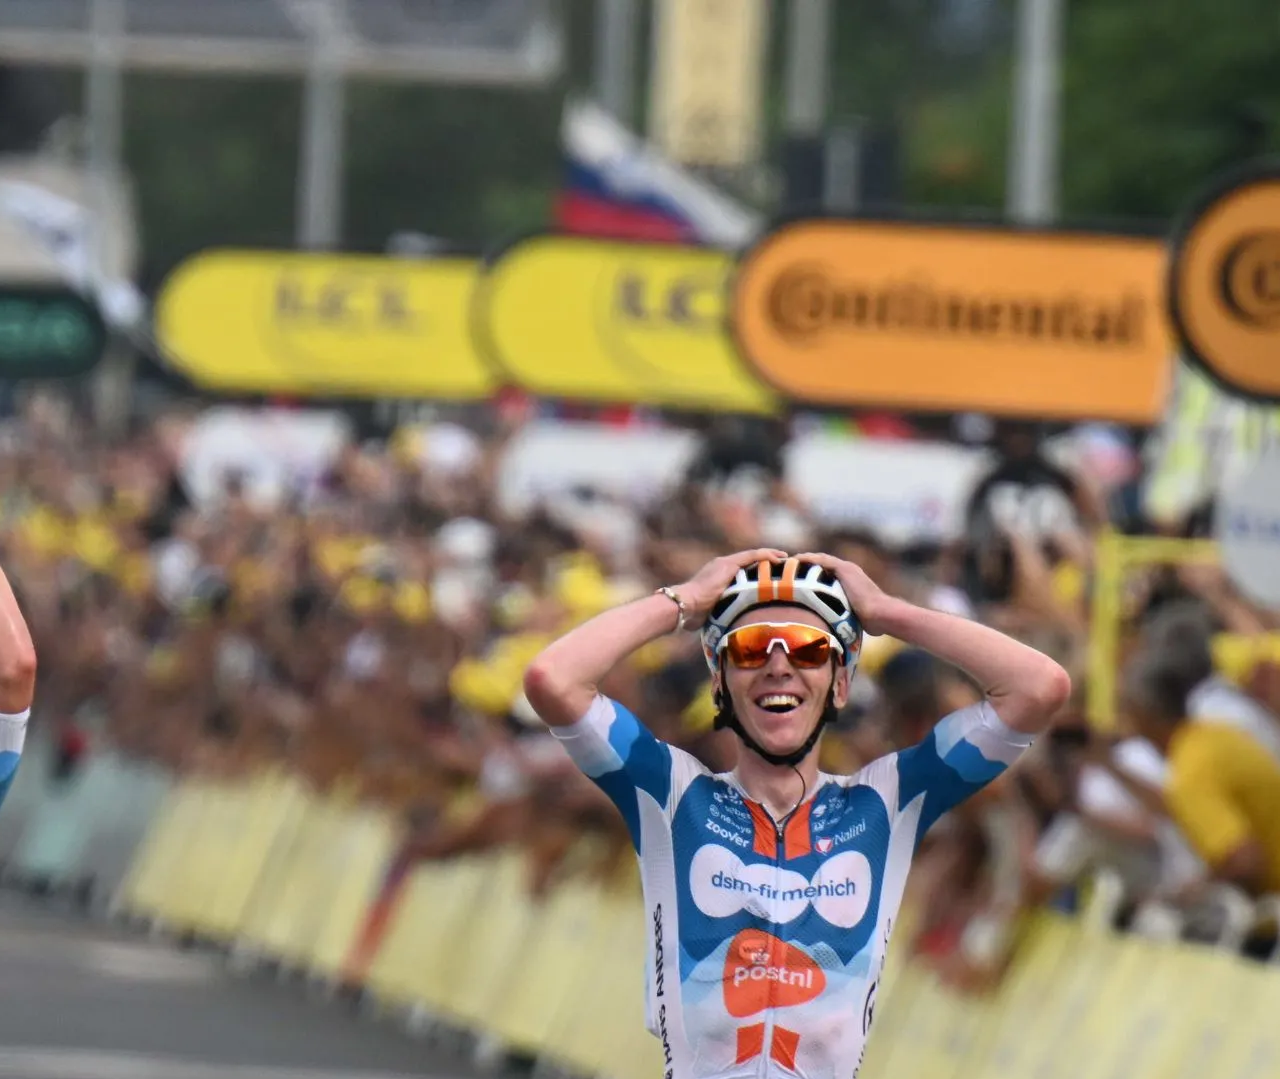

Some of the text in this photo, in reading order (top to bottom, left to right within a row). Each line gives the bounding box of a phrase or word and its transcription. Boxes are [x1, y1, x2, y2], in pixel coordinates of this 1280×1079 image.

[619, 274, 725, 330] LC
[767, 259, 1144, 350] Continental
[705, 818, 750, 848] zoover
[711, 871, 856, 901] dsm-firmenich
[653, 902, 665, 998] ANDERS
[733, 966, 813, 989] postnl
